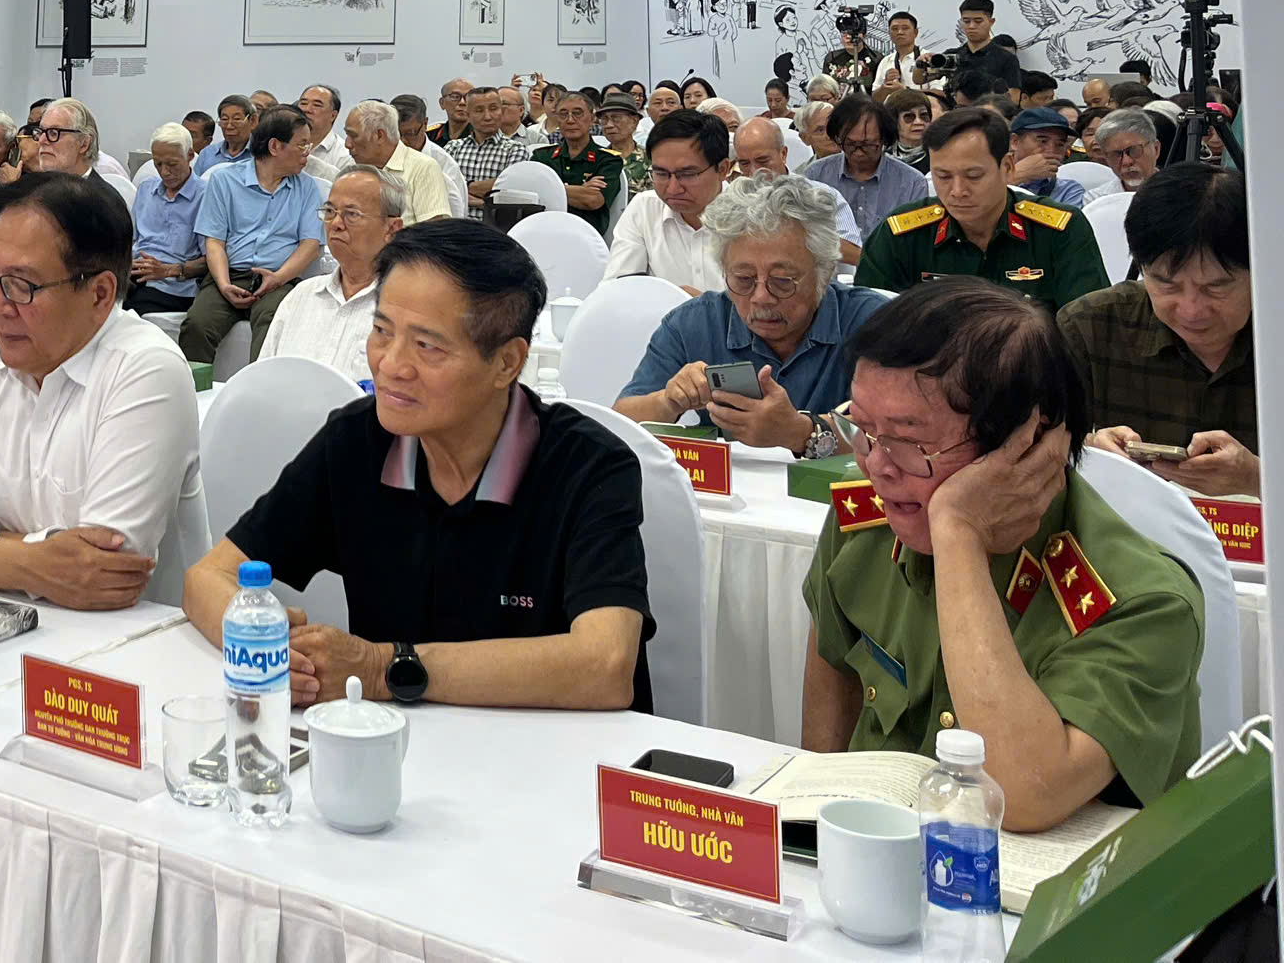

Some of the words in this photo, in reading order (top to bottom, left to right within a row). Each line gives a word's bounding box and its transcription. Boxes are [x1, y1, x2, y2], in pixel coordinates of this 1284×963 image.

[500, 594, 534, 608] BOSS
[85, 681, 92, 693] TS
[68, 696, 88, 717] DUY
[92, 702, 118, 726] QUÁT
[630, 790, 662, 808] TRUNG
[664, 796, 700, 818] TƯỚNG,
[702, 804, 722, 822] NHÀ
[724, 810, 744, 827] VĂN
[644, 820, 684, 852] HỮU
[690, 830, 732, 864] ƯỚC
